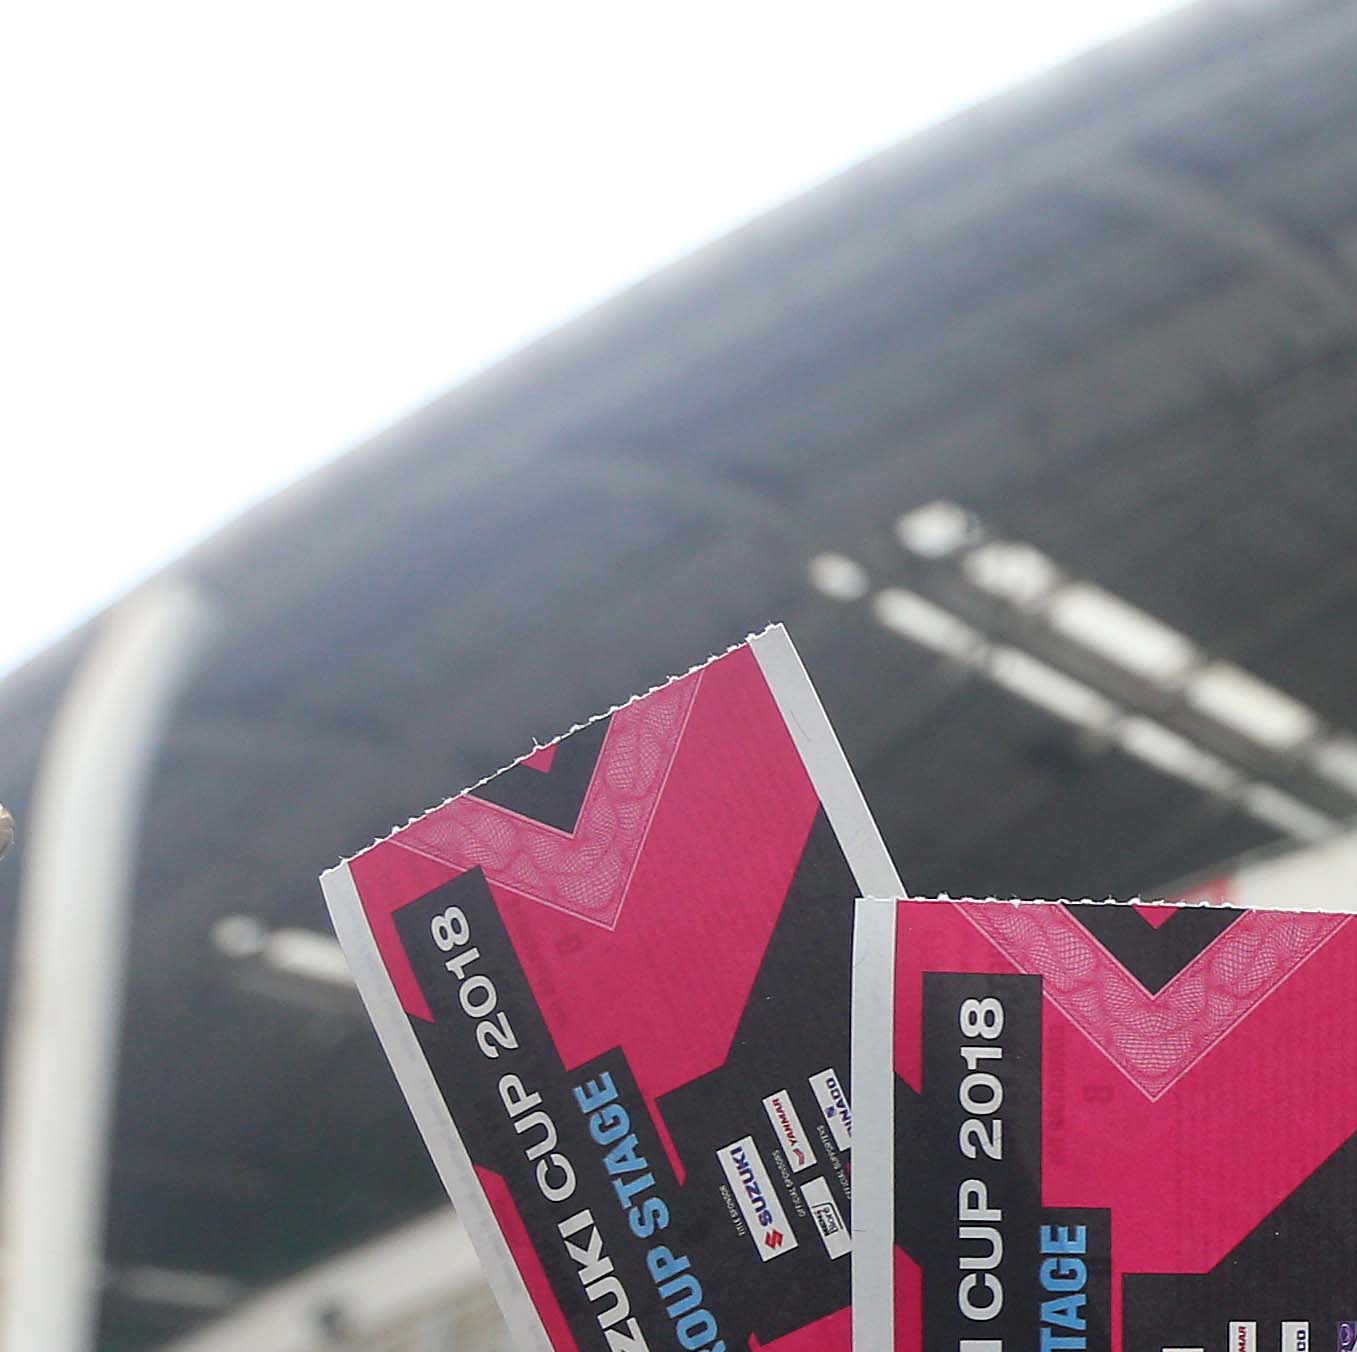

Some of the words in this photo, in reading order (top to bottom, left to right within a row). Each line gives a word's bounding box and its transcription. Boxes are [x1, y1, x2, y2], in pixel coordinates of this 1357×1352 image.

[431, 905, 517, 1059] 2018
[498, 1073, 578, 1203] CUP
[772, 1098, 798, 1145] YANMAR
[958, 997, 1004, 1160] 2018
[572, 1071, 671, 1239] STAGE
[729, 1146, 773, 1227] SUZUKI
[958, 1180, 1004, 1322] CUP
